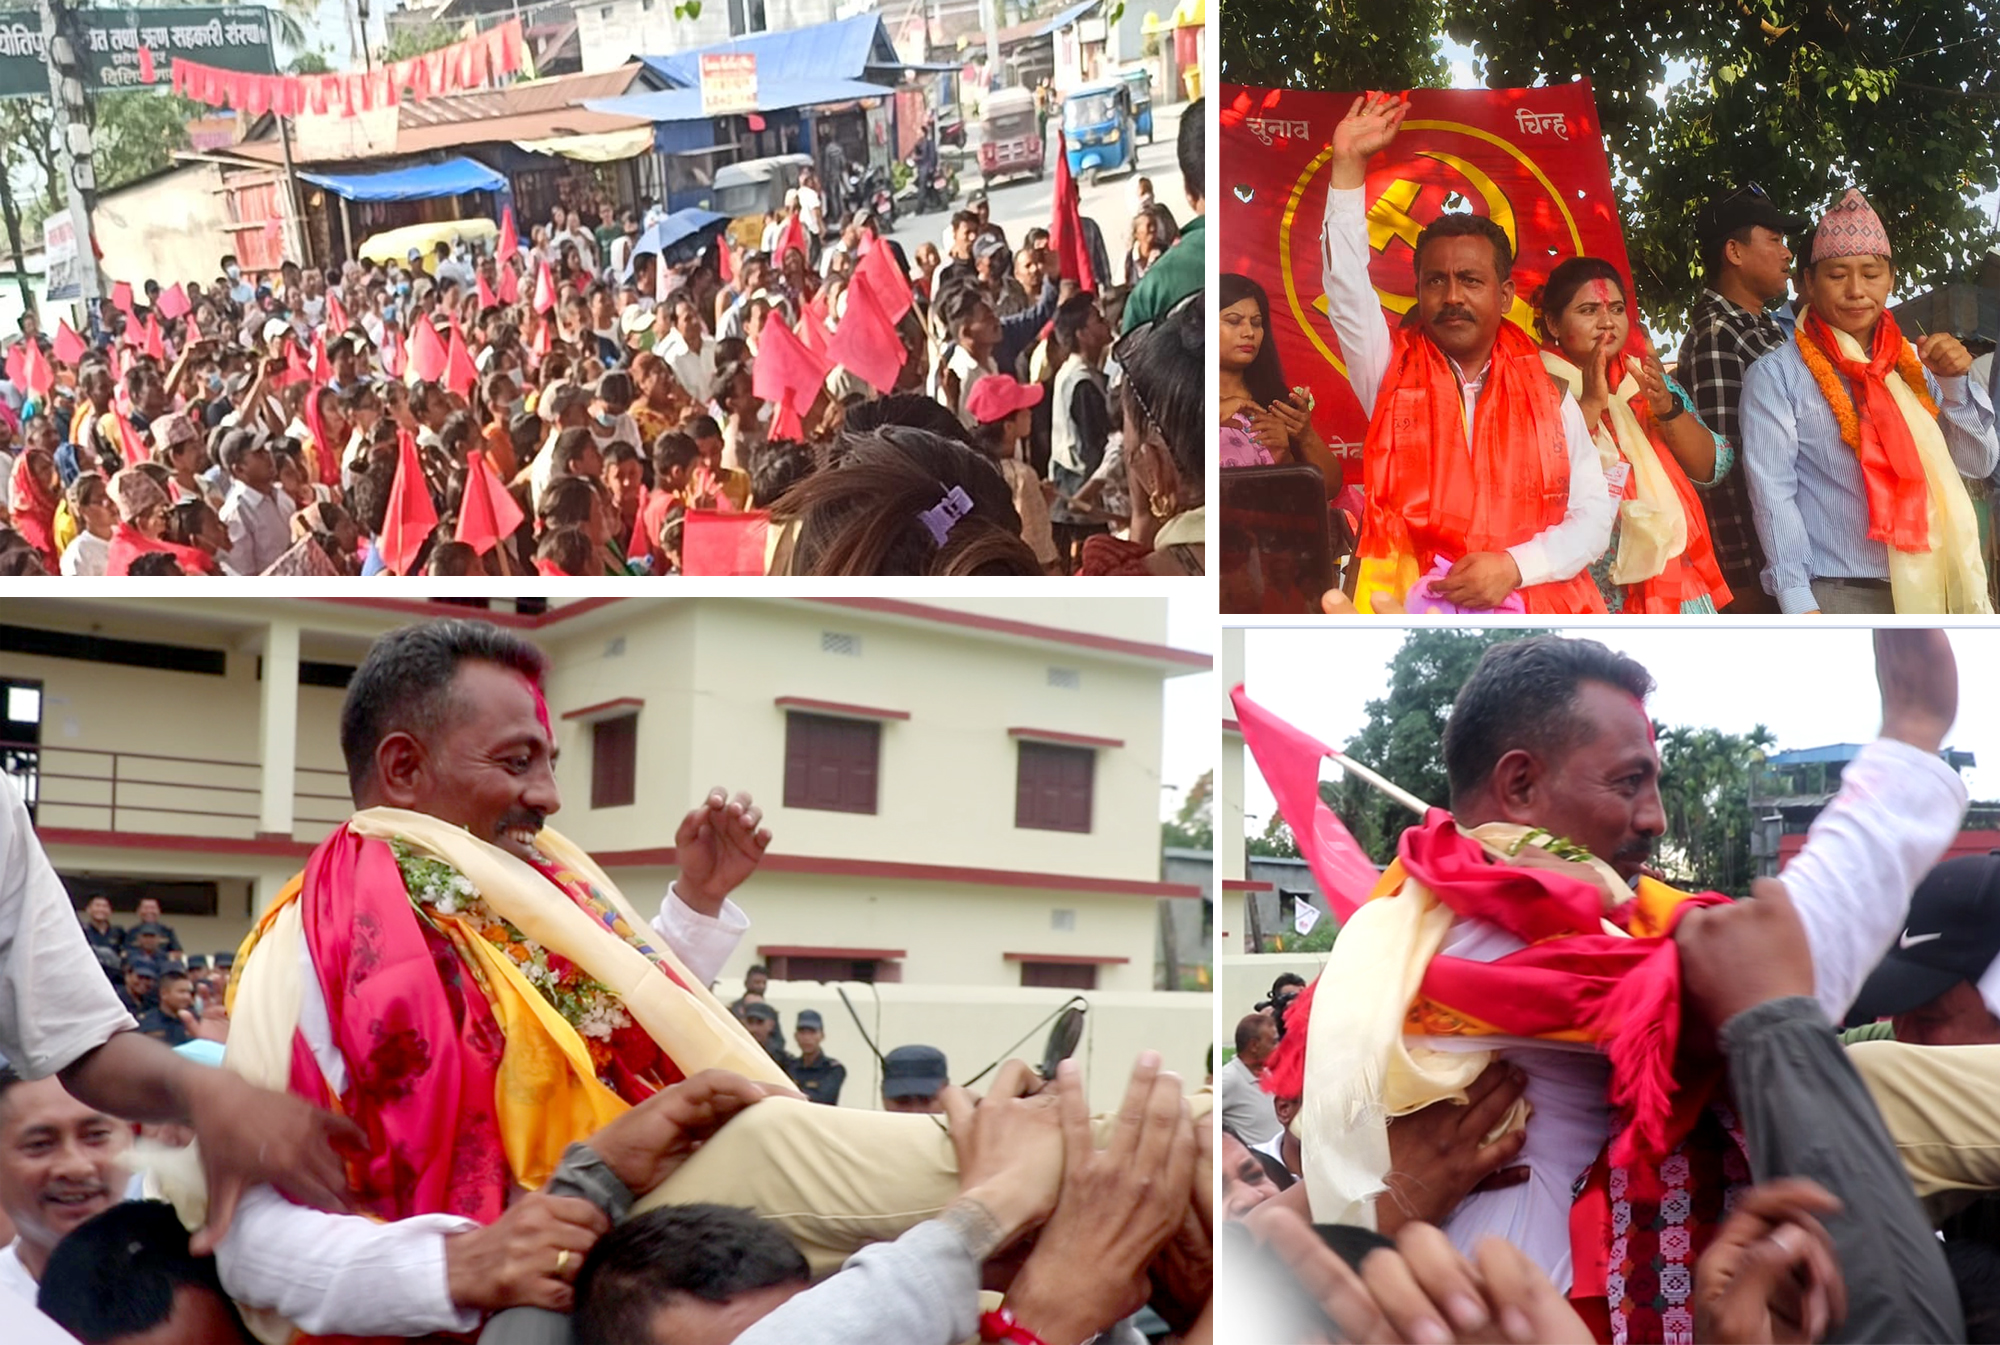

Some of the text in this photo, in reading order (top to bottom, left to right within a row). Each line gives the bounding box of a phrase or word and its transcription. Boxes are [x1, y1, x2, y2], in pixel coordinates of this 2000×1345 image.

[109, 28, 138, 50] तथा
[169, 18, 223, 49] सहकारी
[1245, 108, 1569, 146] चुनाव चिन्ह
